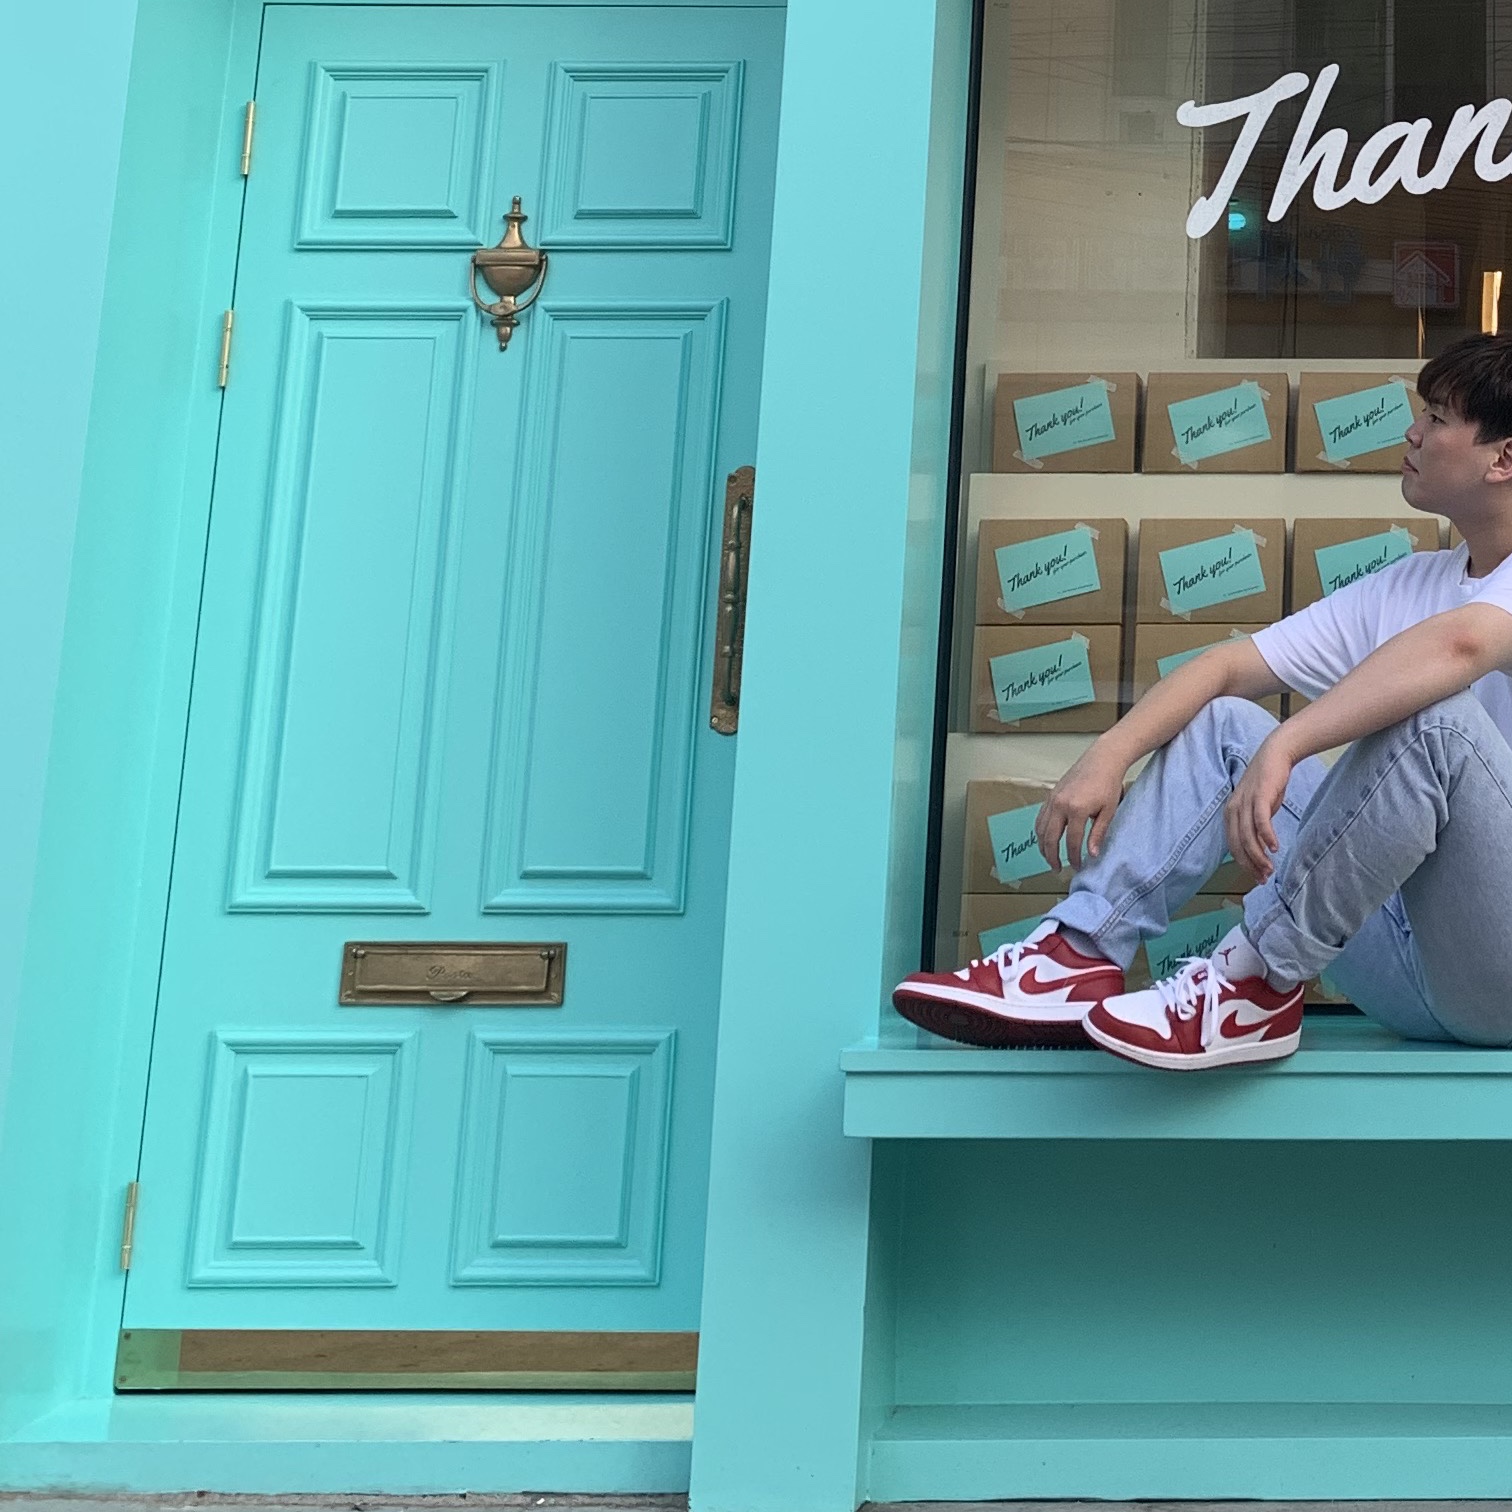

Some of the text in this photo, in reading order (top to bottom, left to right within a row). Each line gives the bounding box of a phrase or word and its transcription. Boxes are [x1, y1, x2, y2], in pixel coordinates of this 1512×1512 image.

[1026, 397, 1083, 441] Thank you!
[1181, 398, 1238, 444] Thank you!
[1328, 398, 1385, 443] Thank you!
[1008, 545, 1067, 592] Thank you!
[1173, 547, 1232, 594] Thank you!
[1329, 564, 1364, 592] Thank
[1002, 654, 1062, 701] Thank you!
[1001, 830, 1037, 863] Thank
